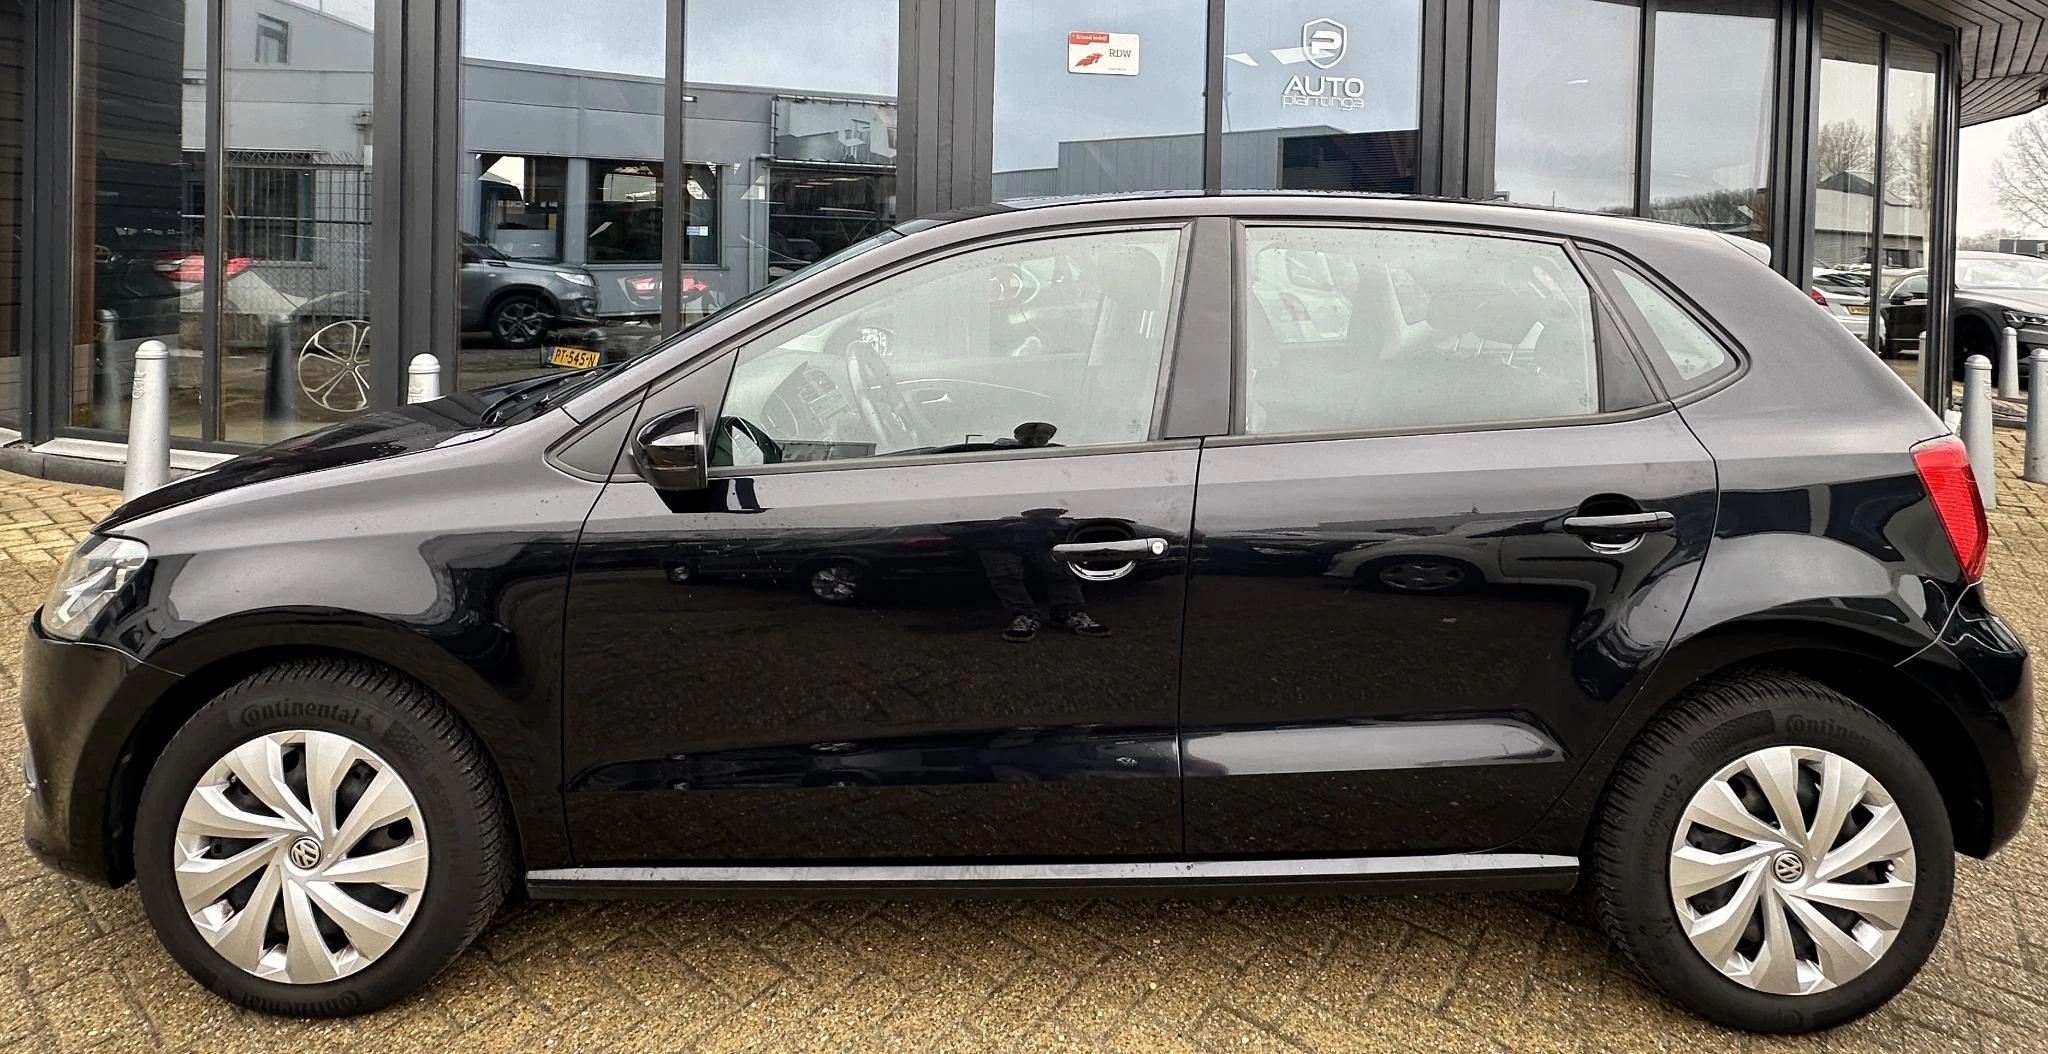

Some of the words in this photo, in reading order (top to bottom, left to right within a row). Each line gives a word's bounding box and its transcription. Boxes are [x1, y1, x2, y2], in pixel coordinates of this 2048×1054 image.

[1108, 48, 1132, 59] RDW
[1283, 75, 1365, 98] AUTO
[1282, 94, 1365, 111] plantinga
[240, 696, 361, 728] Continental
